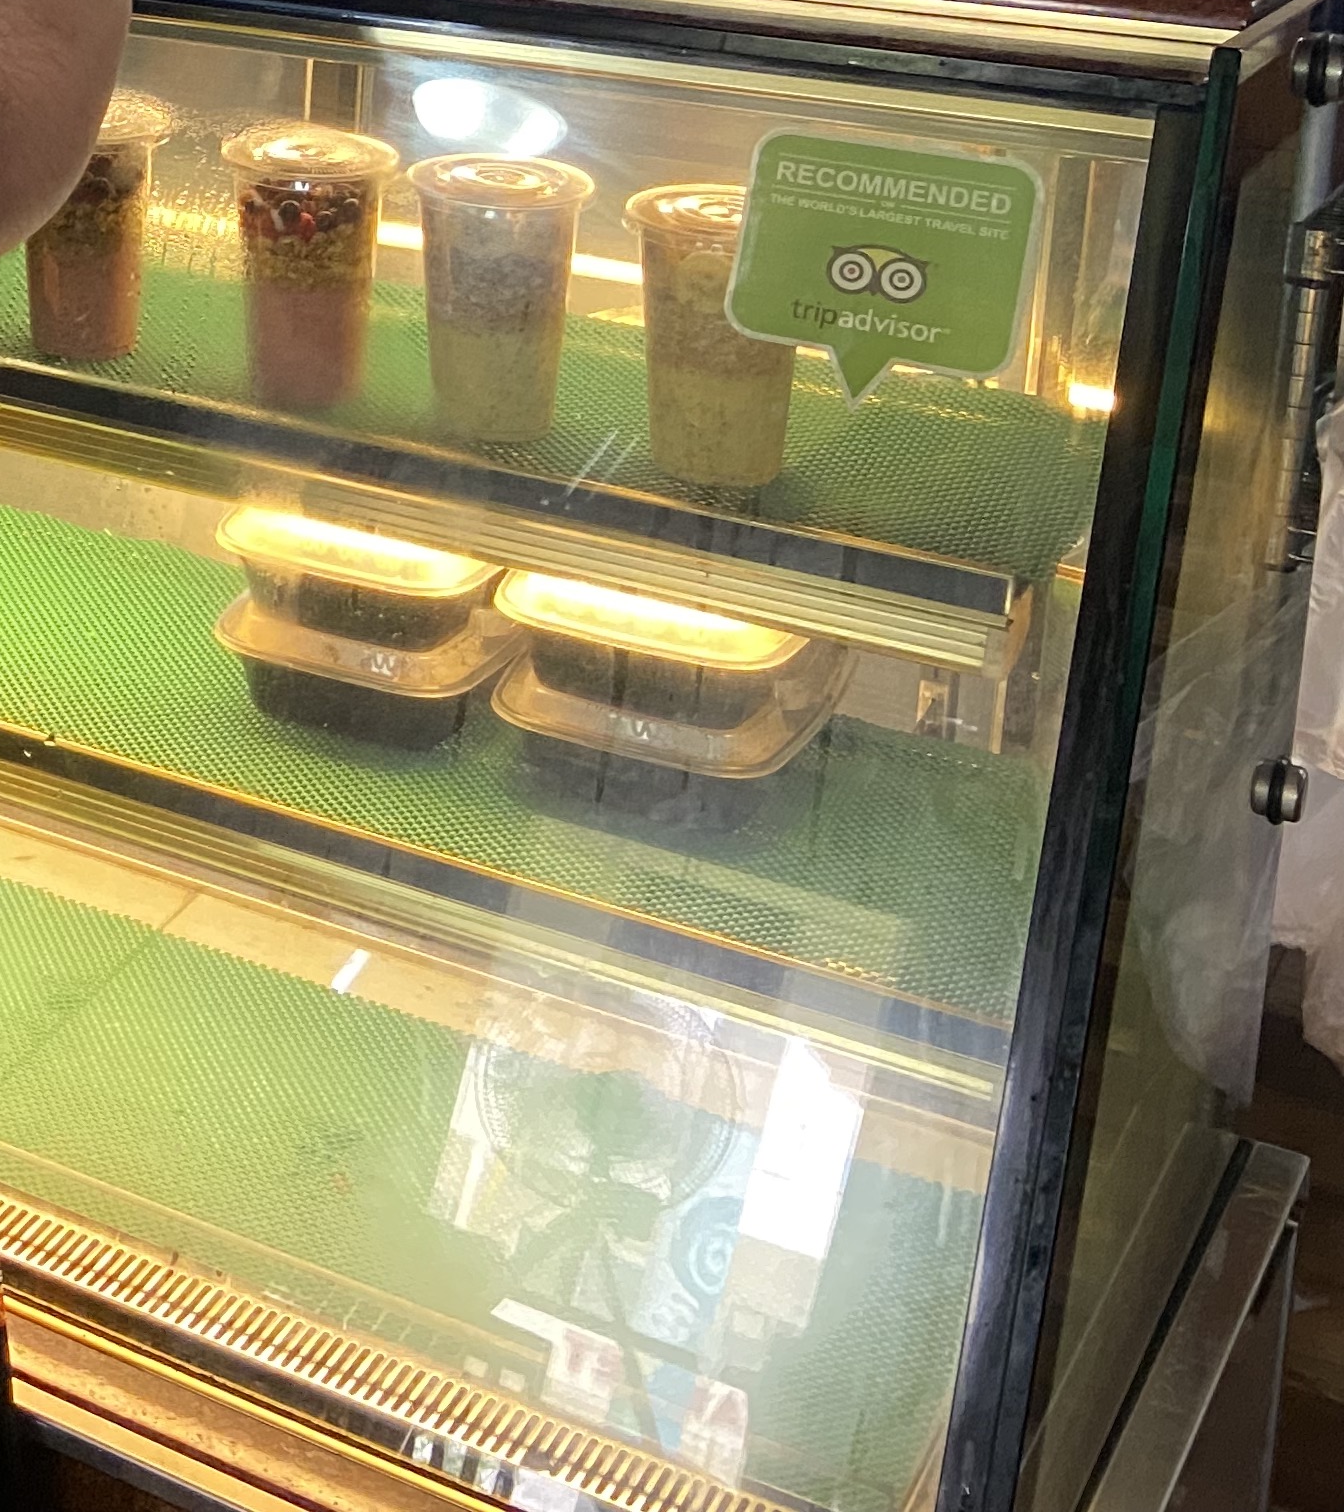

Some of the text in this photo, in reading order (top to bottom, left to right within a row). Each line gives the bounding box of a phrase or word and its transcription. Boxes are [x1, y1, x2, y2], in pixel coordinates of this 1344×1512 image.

[776, 160, 1012, 215] RECOMMENDED
[770, 192, 1009, 240] THE WORLD'S LARGEST TRAVEL SITE
[790, 298, 942, 343] tripadvisor
